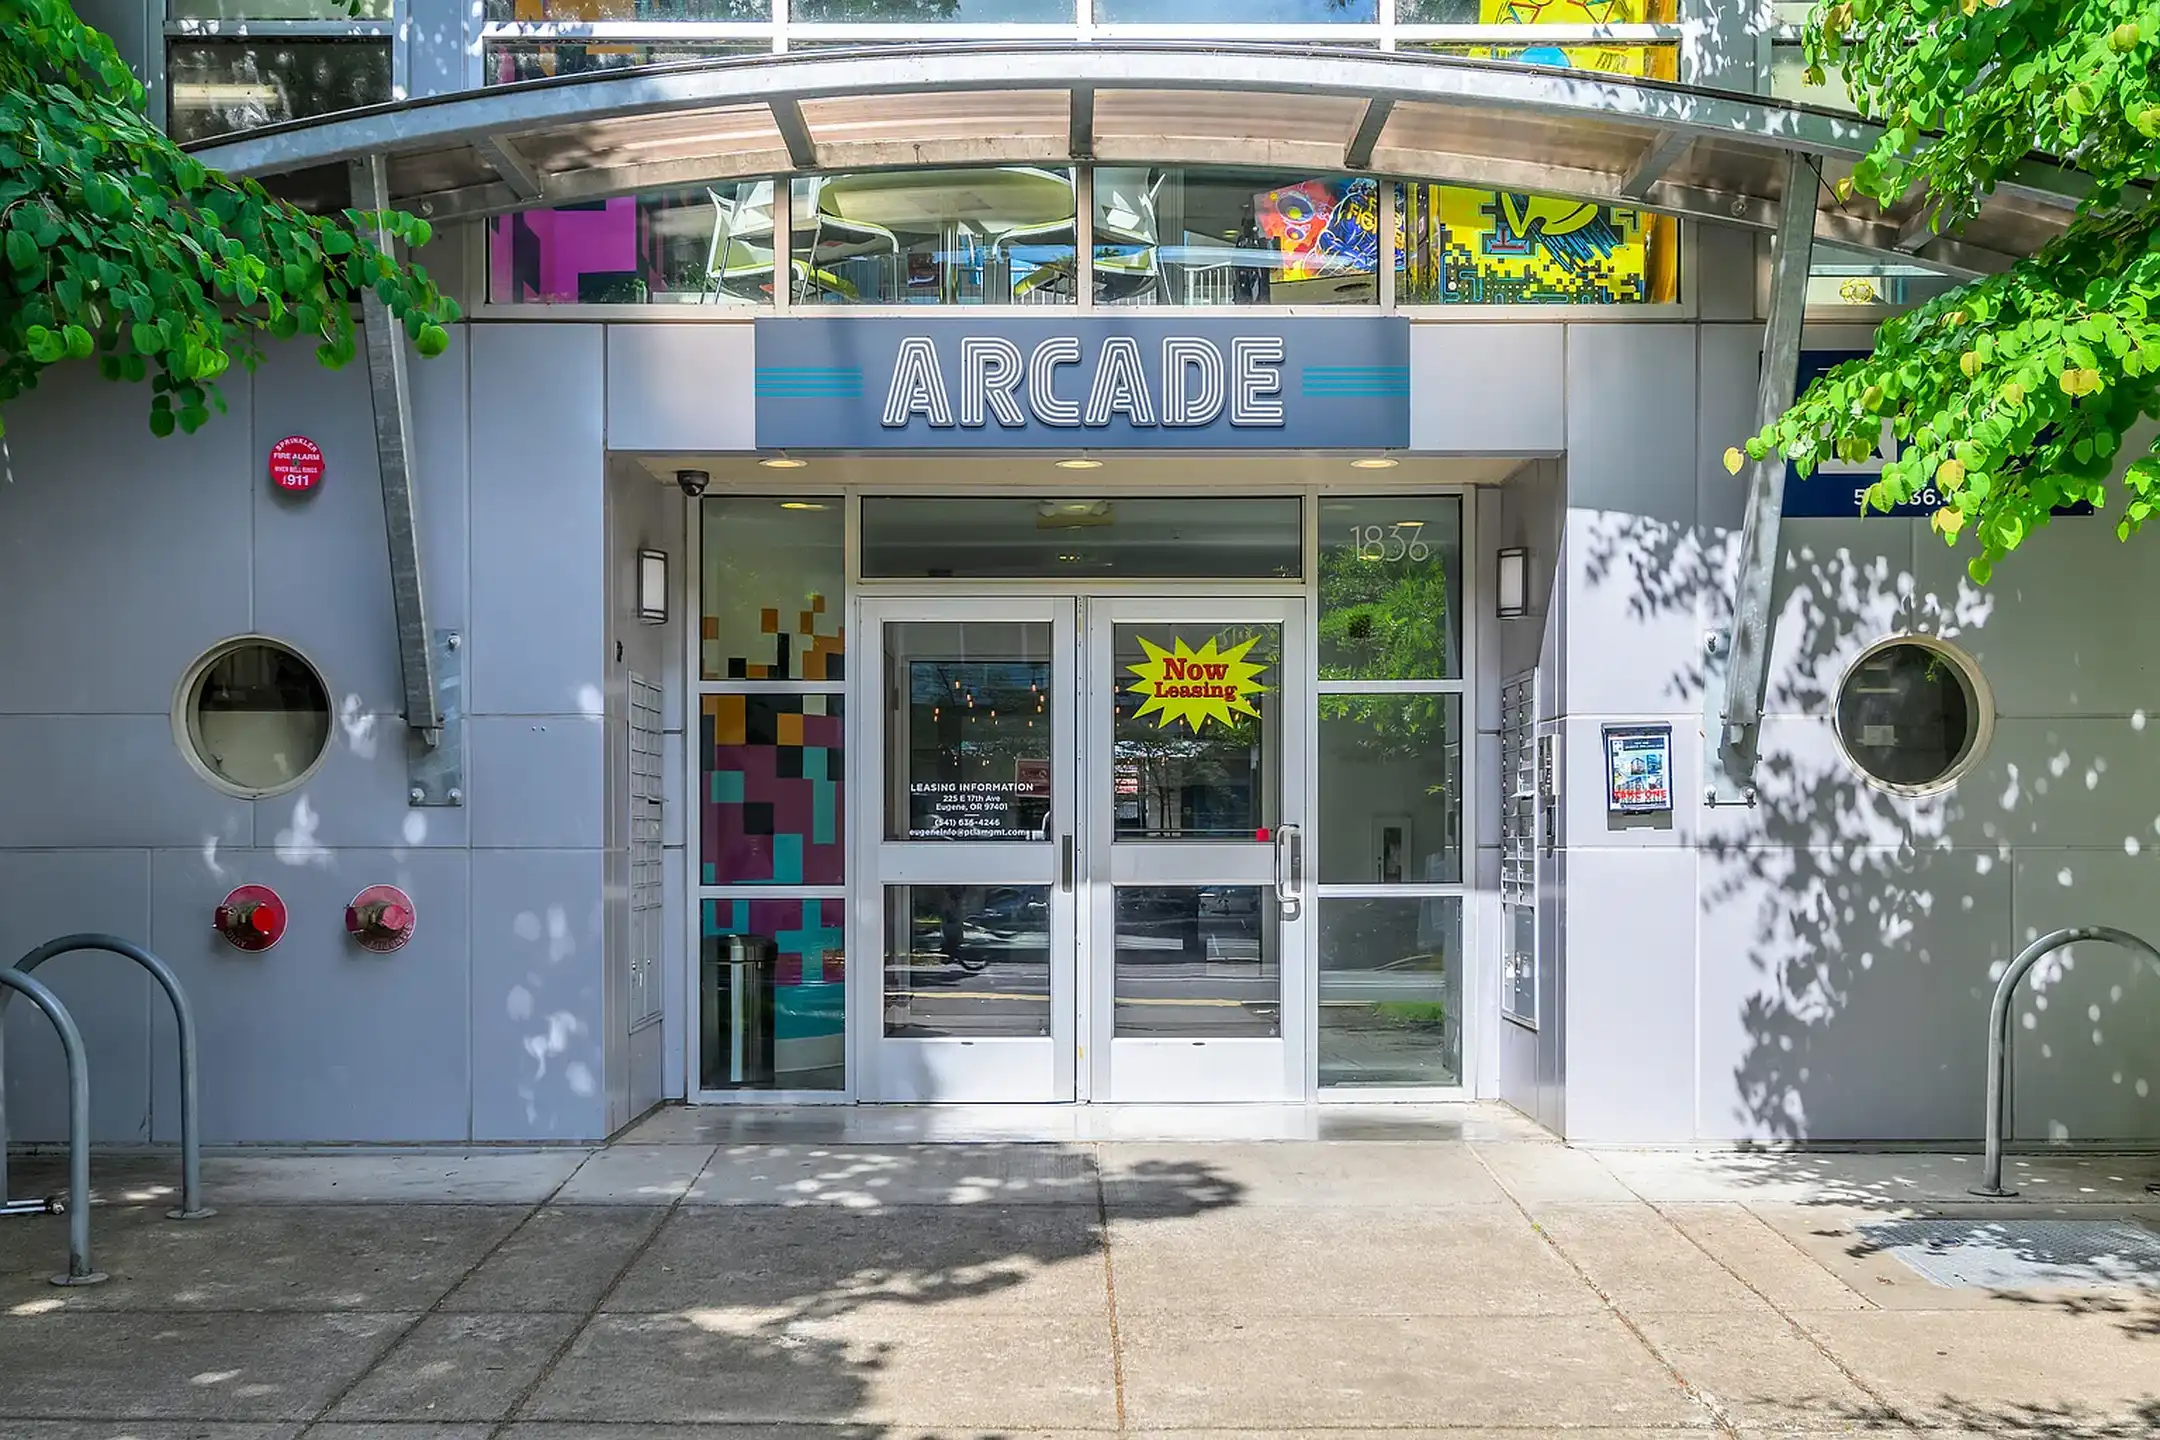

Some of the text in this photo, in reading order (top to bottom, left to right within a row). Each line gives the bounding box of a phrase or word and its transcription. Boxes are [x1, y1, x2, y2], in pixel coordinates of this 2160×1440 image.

[880, 336, 1286, 427] ARCADE
[275, 437, 318, 452] SPRINKLER
[1350, 525, 1429, 562] 1836
[1162, 658, 1229, 680] Now
[1154, 681, 1238, 702] Leasing
[910, 783, 1034, 792] LEASING INFORMATION
[943, 794, 959, 802] 225
[960, 794, 966, 802] E
[967, 794, 984, 802] 17th
[1645, 789, 1667, 800] ONE
[936, 803, 968, 811] Eugene,
[935, 818, 957, 827] (541)
